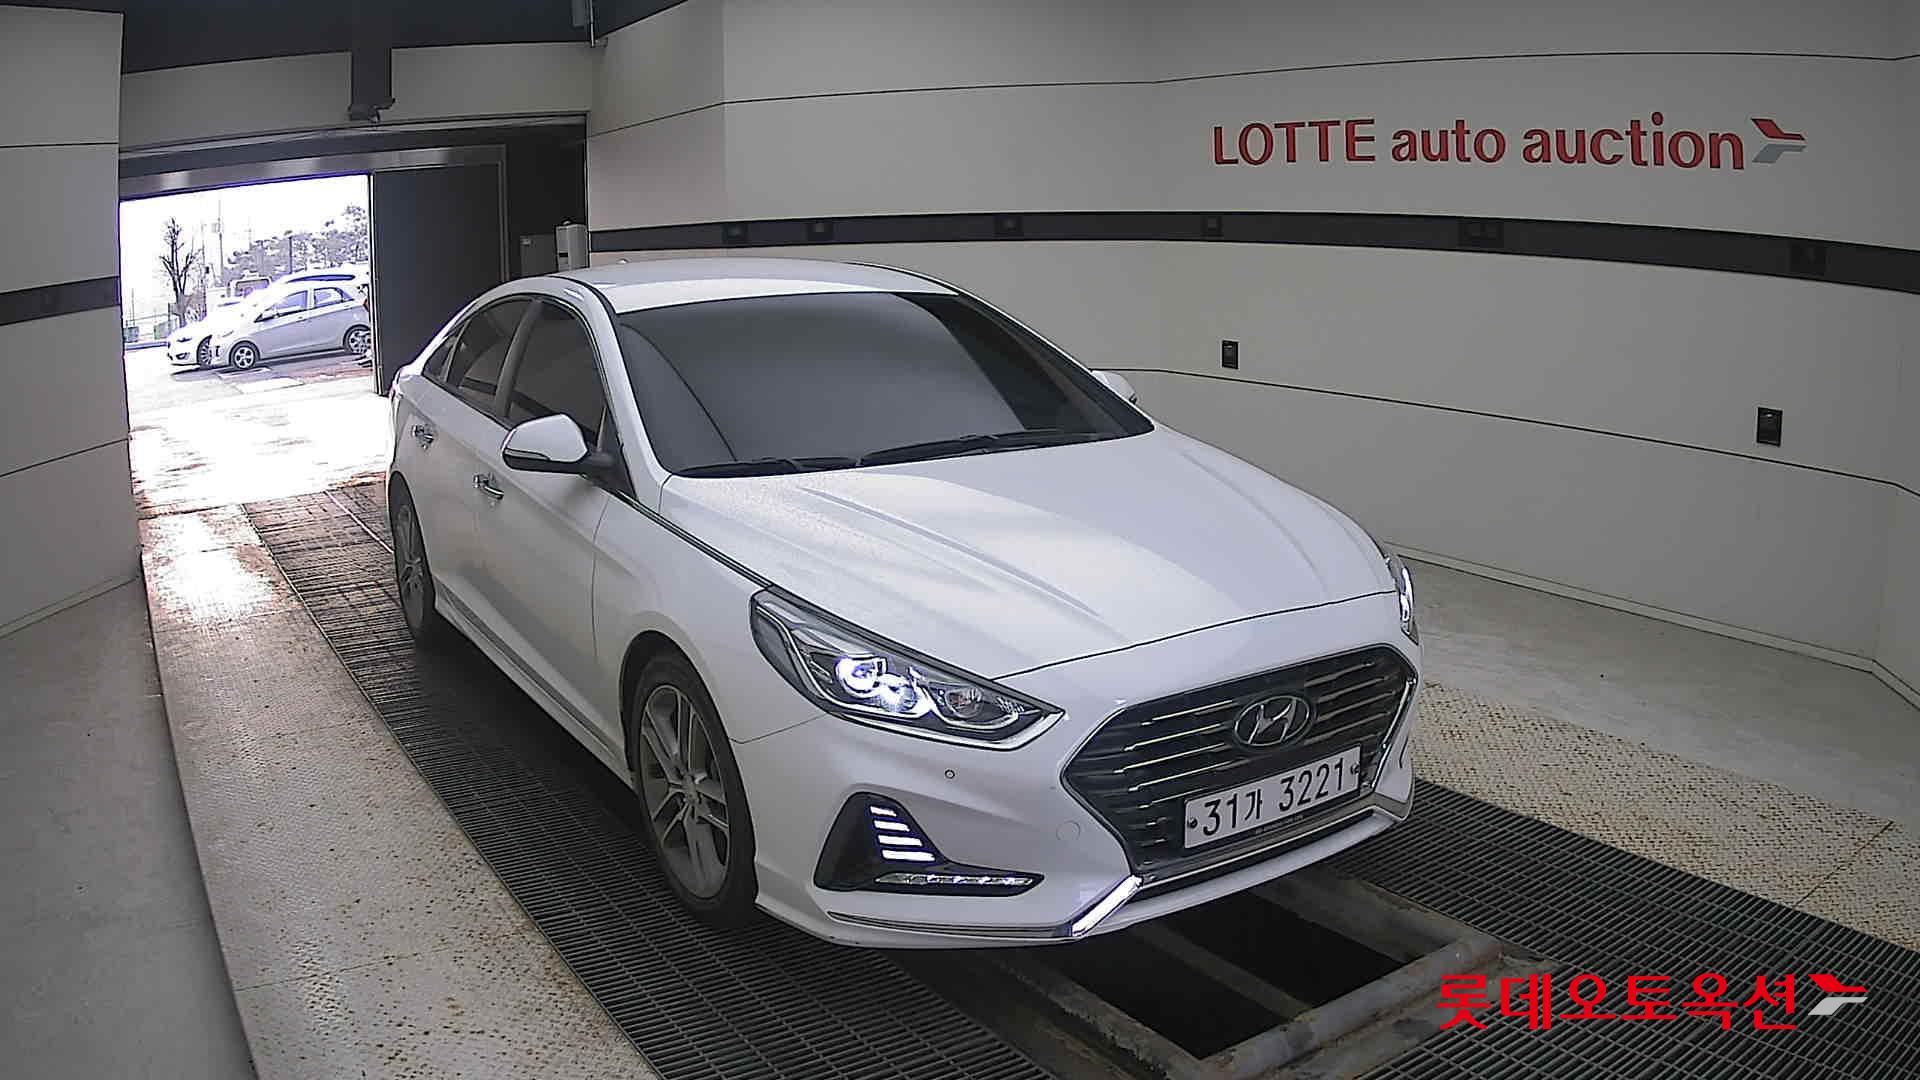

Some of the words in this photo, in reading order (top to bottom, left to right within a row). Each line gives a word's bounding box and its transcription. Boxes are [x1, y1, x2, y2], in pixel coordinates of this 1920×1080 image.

[1213, 118, 1377, 166] LOTTE
[1391, 119, 1507, 164] auto
[1522, 111, 1745, 171] auction
[1202, 787, 1264, 837] 31가
[1278, 757, 1345, 813] 3221
